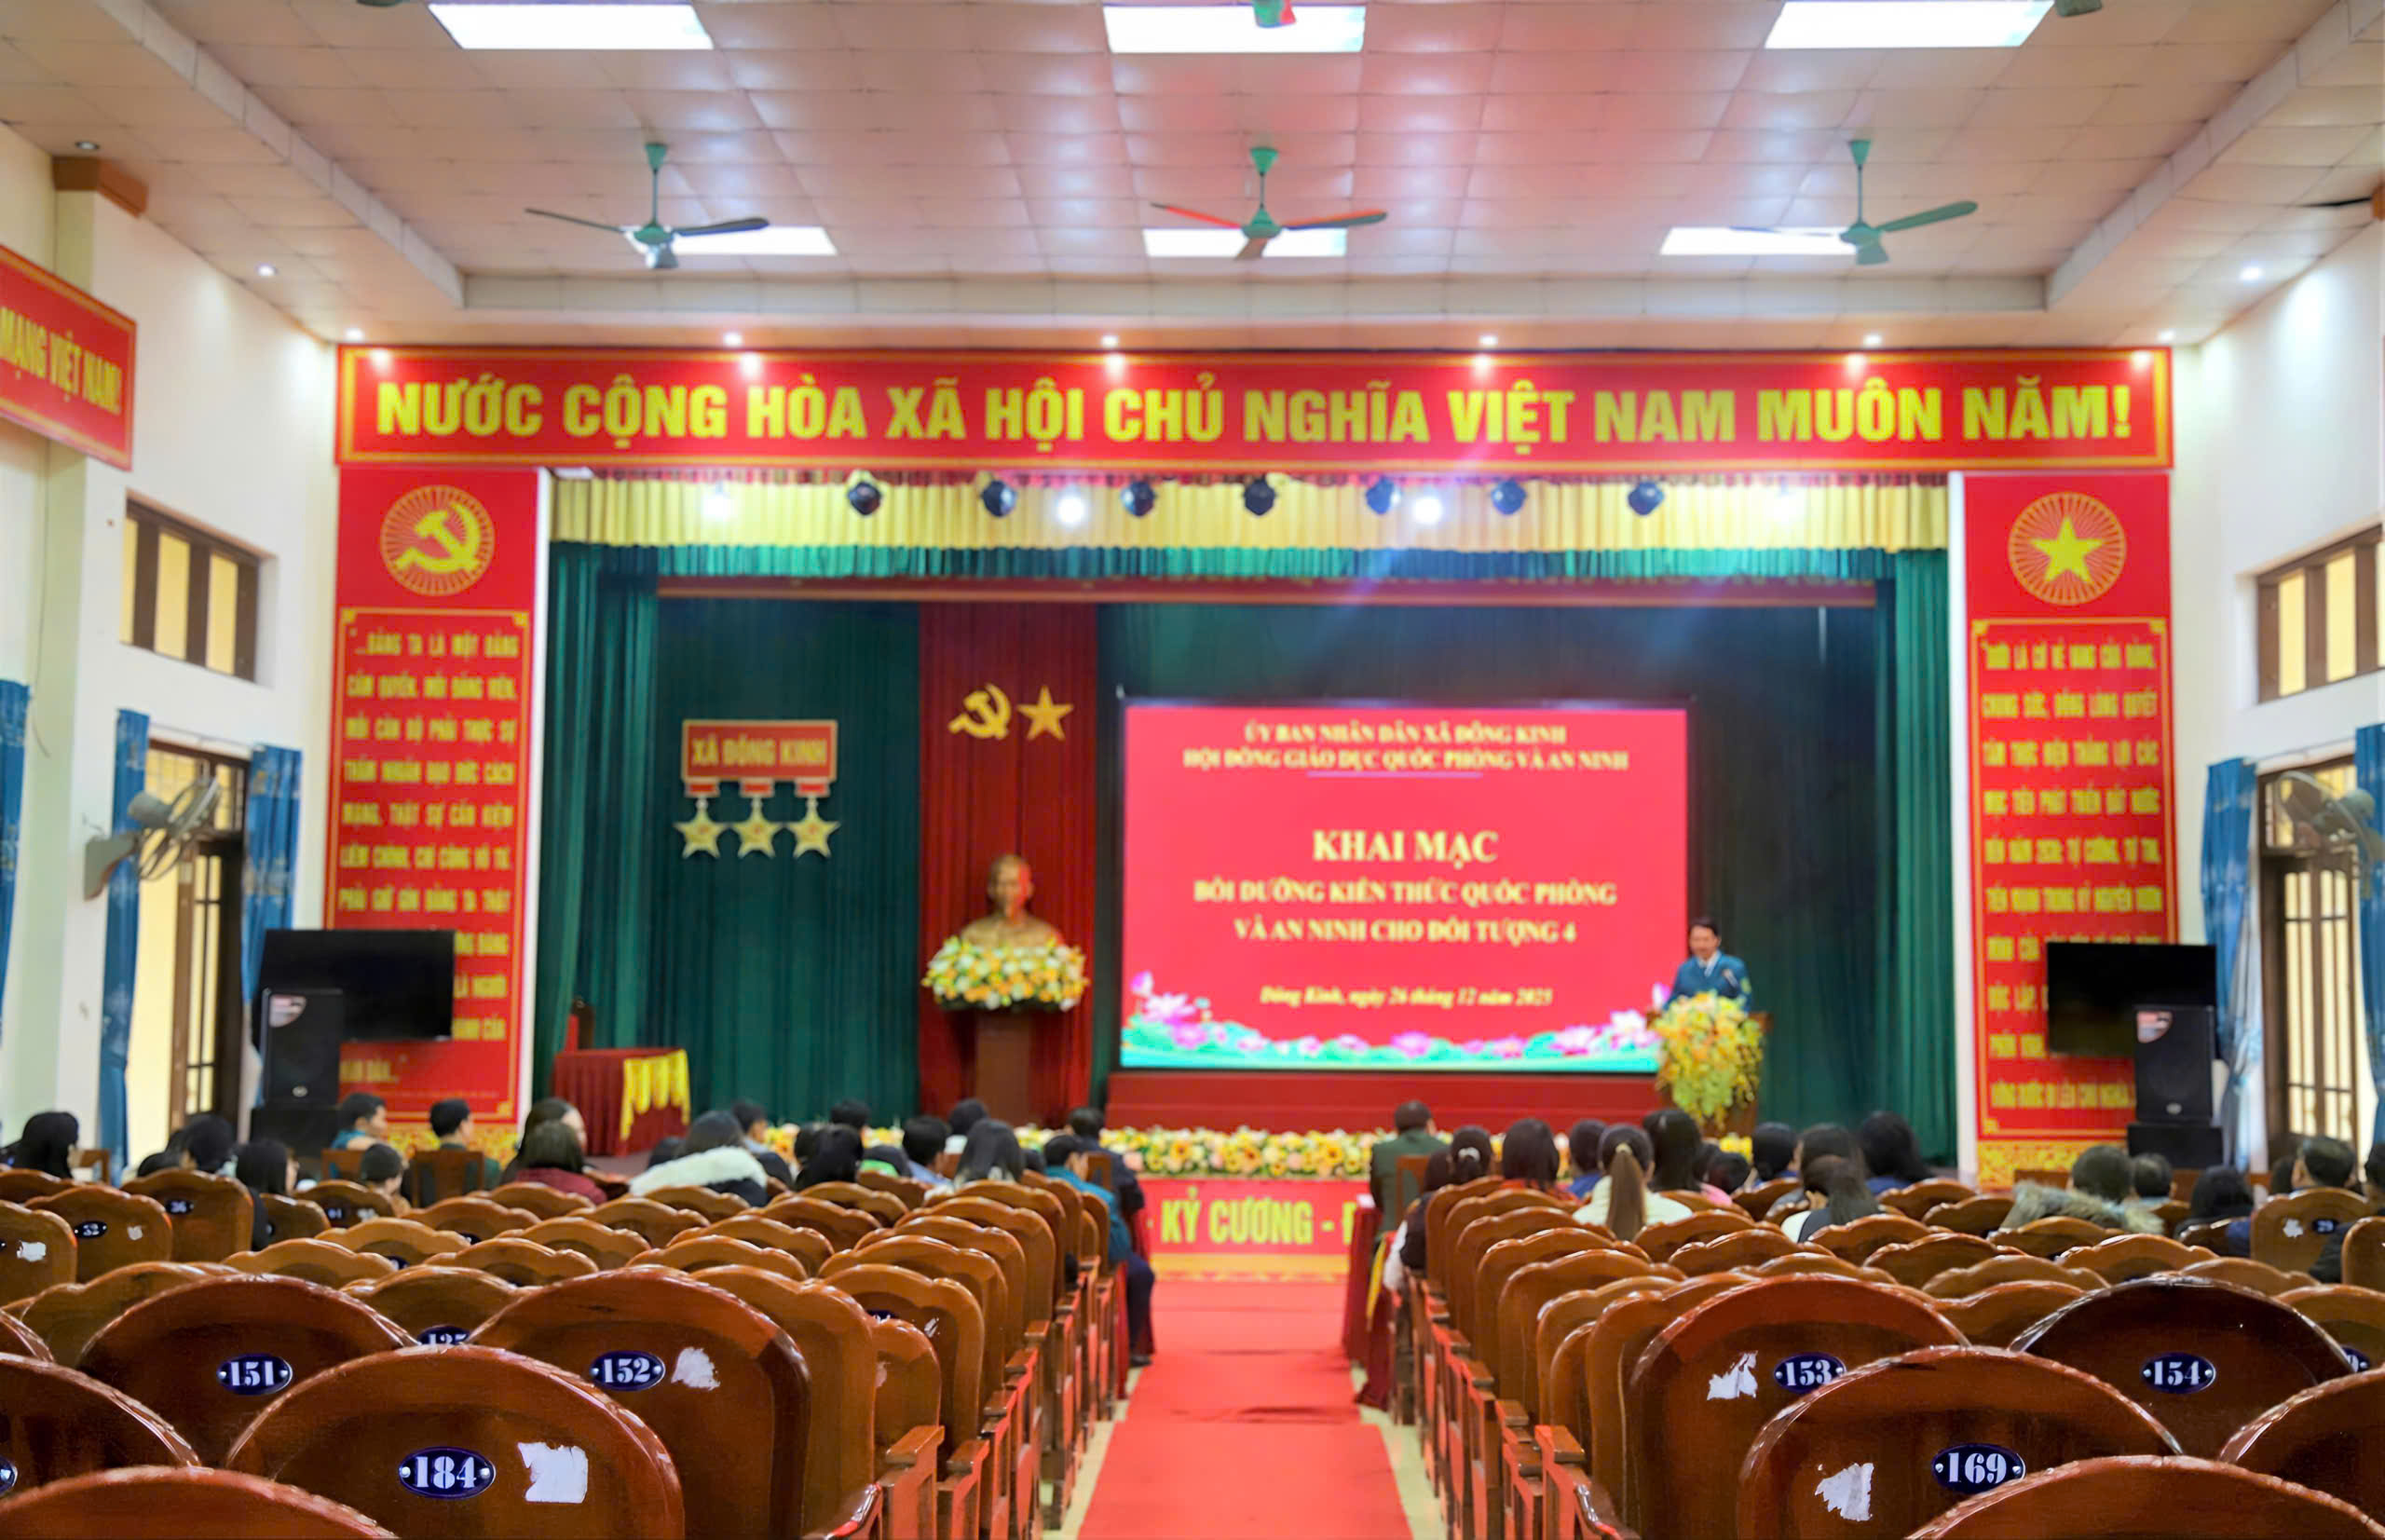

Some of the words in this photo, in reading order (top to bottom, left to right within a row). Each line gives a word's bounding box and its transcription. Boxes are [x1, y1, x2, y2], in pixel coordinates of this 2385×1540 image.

[376, 374, 542, 438] NƯỚC
[564, 375, 729, 449] CỘNG
[746, 374, 867, 440] HÒA
[886, 378, 966, 440] XÃ
[986, 376, 1084, 453] HỘI
[1103, 373, 1223, 442] CHỦ
[1244, 381, 1430, 443] NGHĨA
[1447, 378, 1575, 455] VIỆT
[1594, 389, 1736, 443] NAM
[1758, 376, 1942, 443] MUÔN
[1963, 375, 2133, 440] NĂM!
[1274, 724, 1316, 743] BAN
[1318, 718, 1375, 743] NHÂN
[1515, 724, 1567, 744] KINH
[1577, 750, 1629, 771] NINH
[1312, 828, 1405, 862] KHAI
[1413, 828, 1499, 870] MẠC
[1270, 920, 1303, 941] AN
[1307, 919, 1368, 942] NINH
[1370, 919, 1424, 943] CHO
[1161, 1186, 1202, 1244] KỶ
[1208, 1195, 1314, 1245] CƯƠNG
[229, 1360, 276, 1387] 151
[601, 1356, 651, 1384] 152
[1784, 1359, 1833, 1387] 153
[2152, 1359, 2201, 1386] 154
[414, 1455, 477, 1490] 184
[1947, 1451, 2008, 1485] 169
